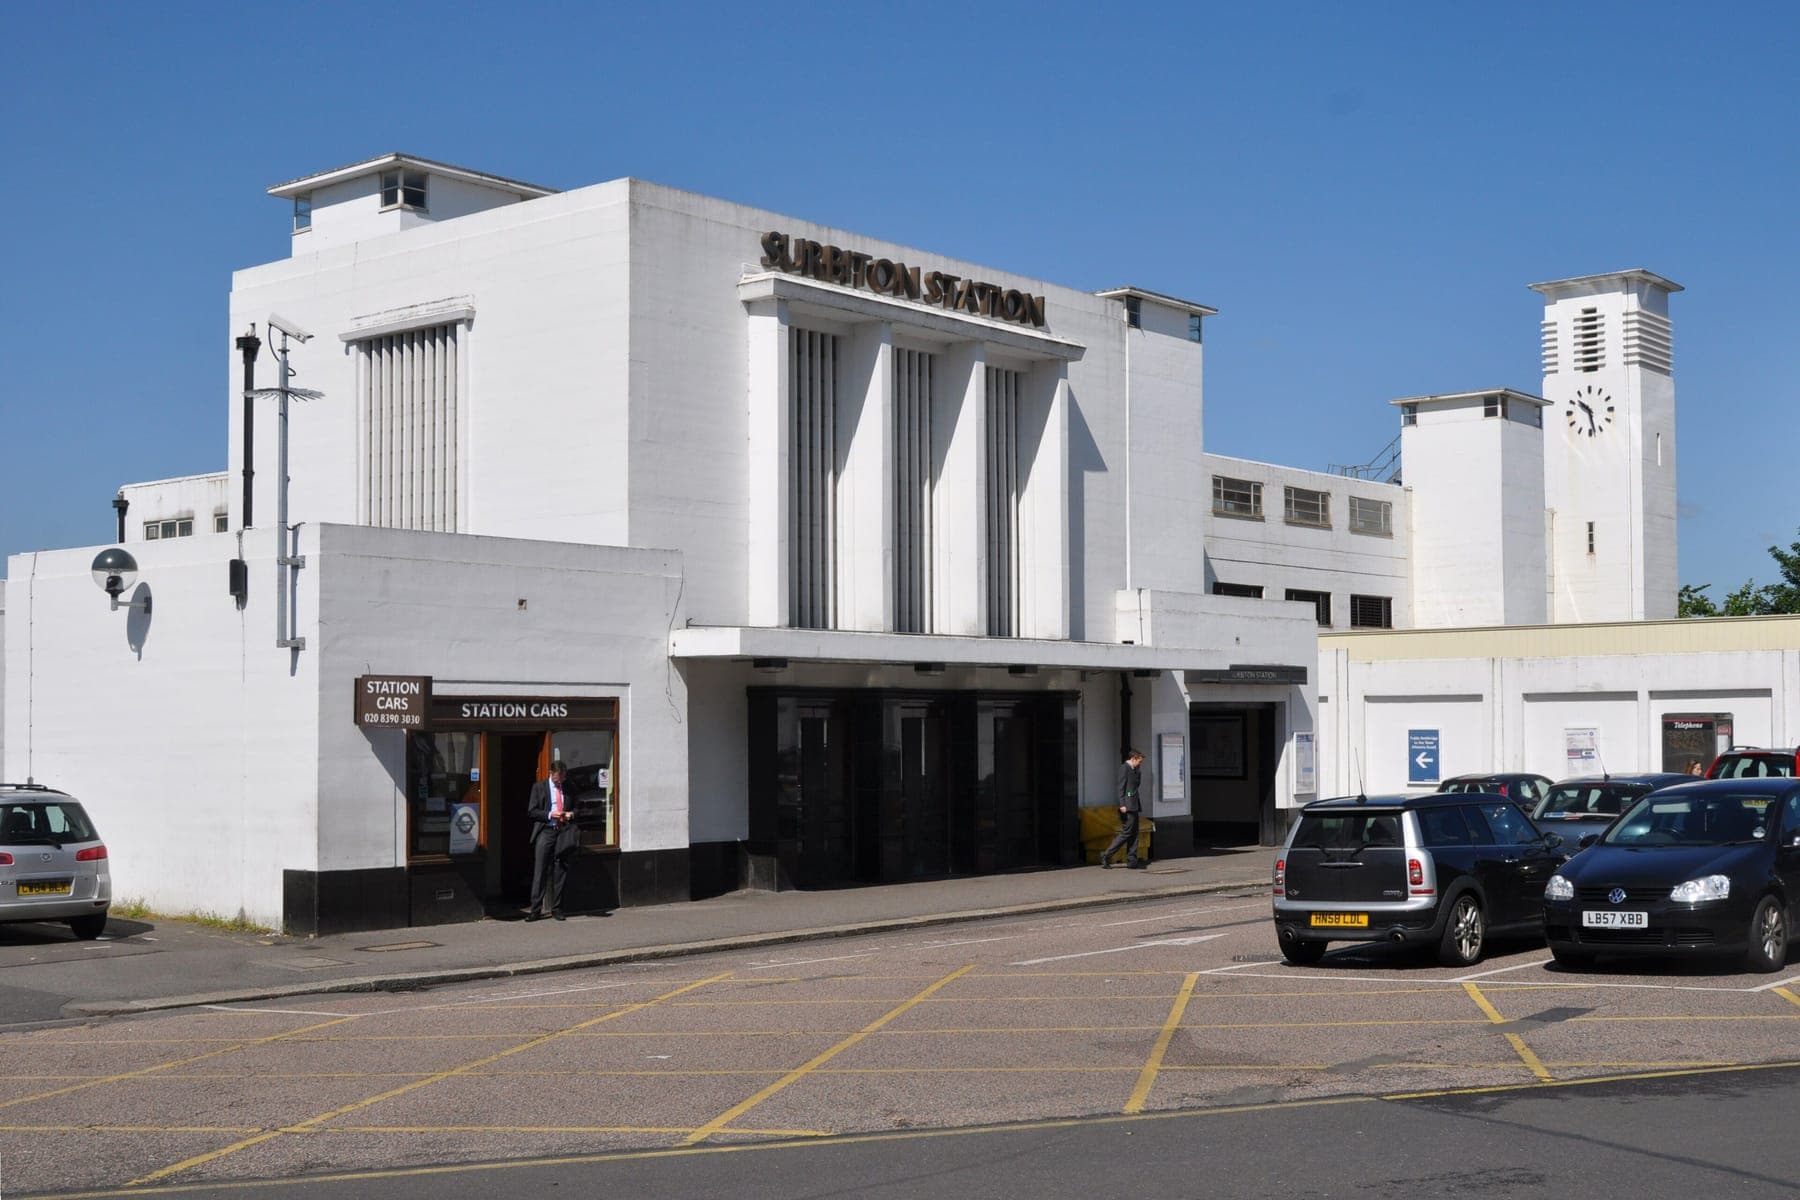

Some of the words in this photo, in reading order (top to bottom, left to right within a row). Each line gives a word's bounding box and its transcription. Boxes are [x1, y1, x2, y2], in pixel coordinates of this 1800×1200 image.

[761, 231, 920, 300] SURBITON
[923, 271, 1045, 327] STATION
[367, 680, 420, 694] STATION
[376, 696, 409, 710] CARS
[461, 703, 526, 718] STATION
[530, 703, 568, 718] CARS
[364, 712, 379, 723] 020
[380, 713, 399, 724] 8390
[401, 714, 420, 724] 3030
[1673, 720, 1704, 730] Telephone
[1587, 912, 1616, 925] LB57
